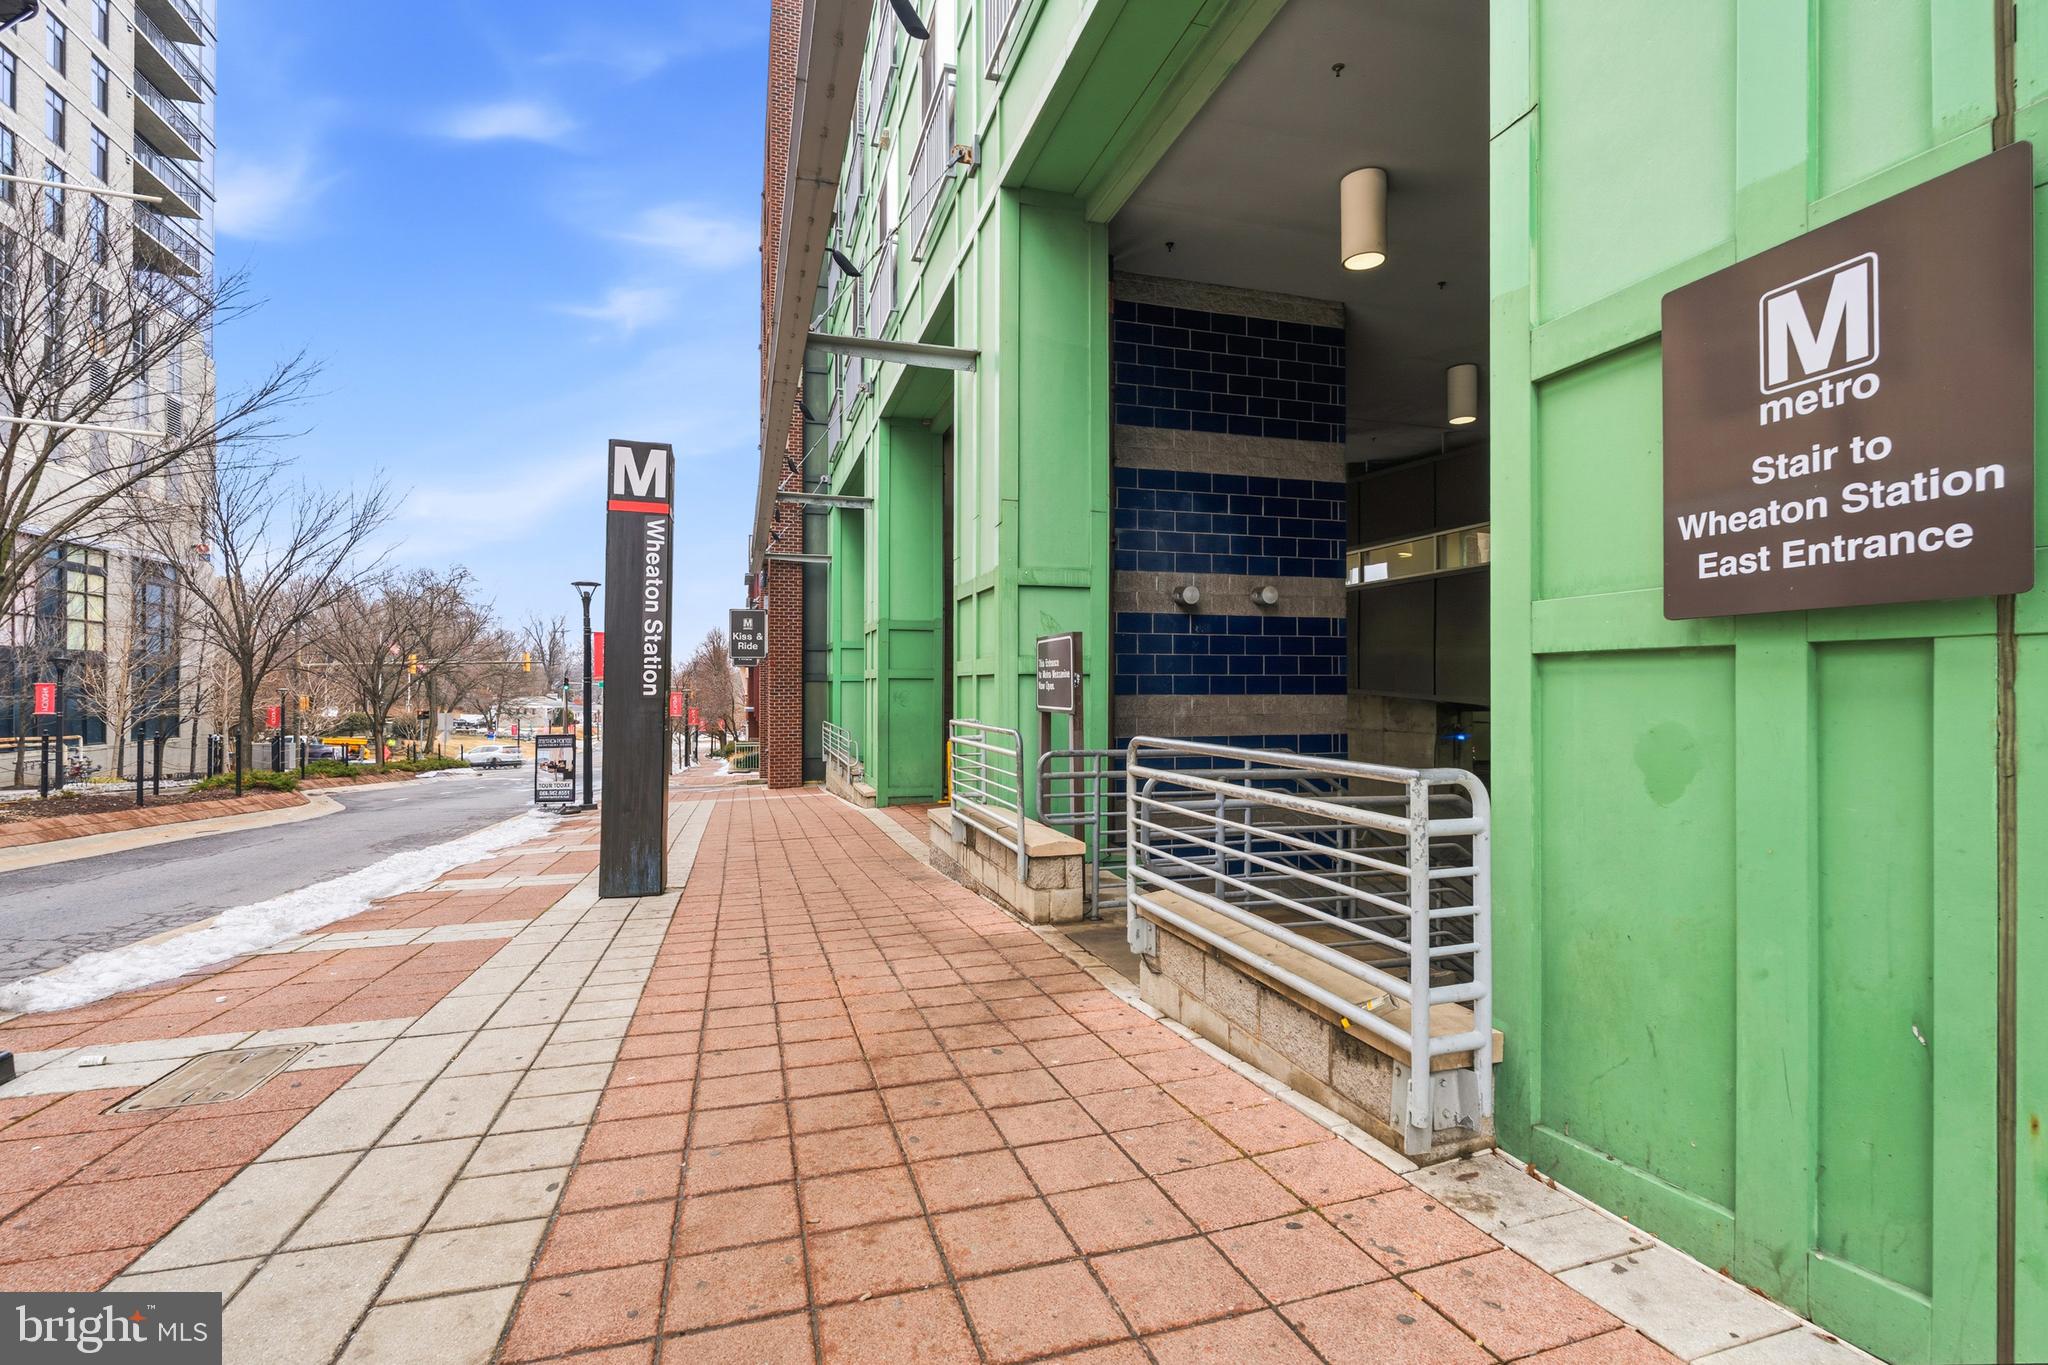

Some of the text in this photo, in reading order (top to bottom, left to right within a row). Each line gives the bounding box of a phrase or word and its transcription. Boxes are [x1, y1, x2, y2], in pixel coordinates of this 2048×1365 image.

[1767, 262, 1870, 387] M
[1760, 373, 1880, 426] metro
[613, 446, 667, 498] M
[1752, 434, 1893, 485] Stair to
[1677, 463, 2006, 541] Wheaton Station
[1698, 521, 1974, 580] East Entrance
[642, 519, 665, 696] Wheaton Station
[732, 632, 764, 641] Kiss &
[737, 642, 759, 650] Ride
